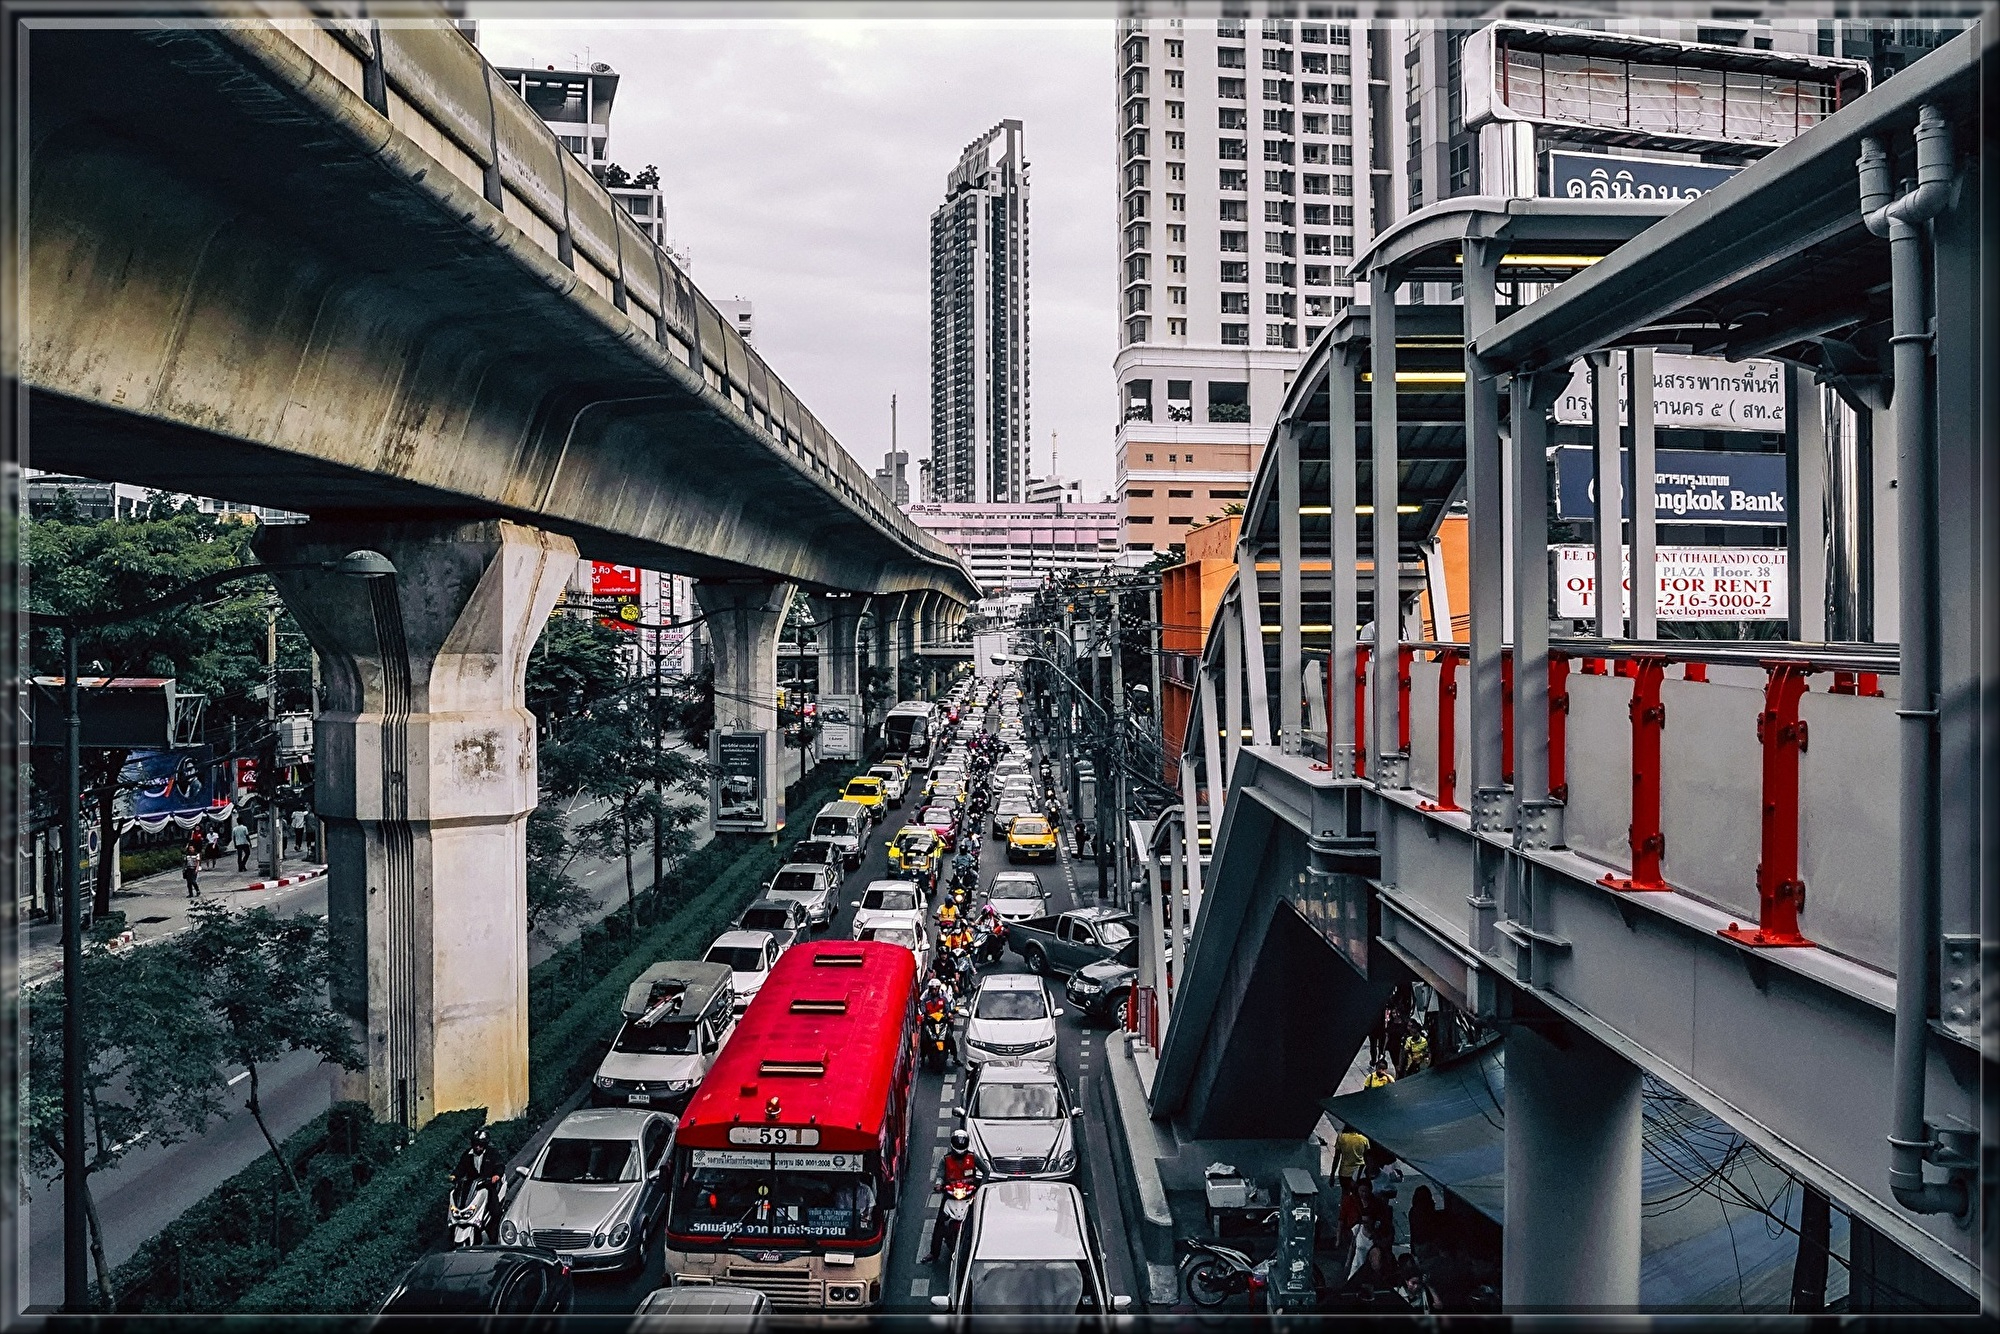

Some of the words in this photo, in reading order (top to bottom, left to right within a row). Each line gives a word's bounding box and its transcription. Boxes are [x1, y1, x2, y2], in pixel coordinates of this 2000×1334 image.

[1730, 490, 1784, 512] Bank
[1663, 567, 1705, 577] PLAZA
[1713, 566, 1753, 577] Floor.
[1757, 567, 1771, 577] 38
[1660, 578, 1704, 592] FOR
[1714, 580, 1772, 593] RENT
